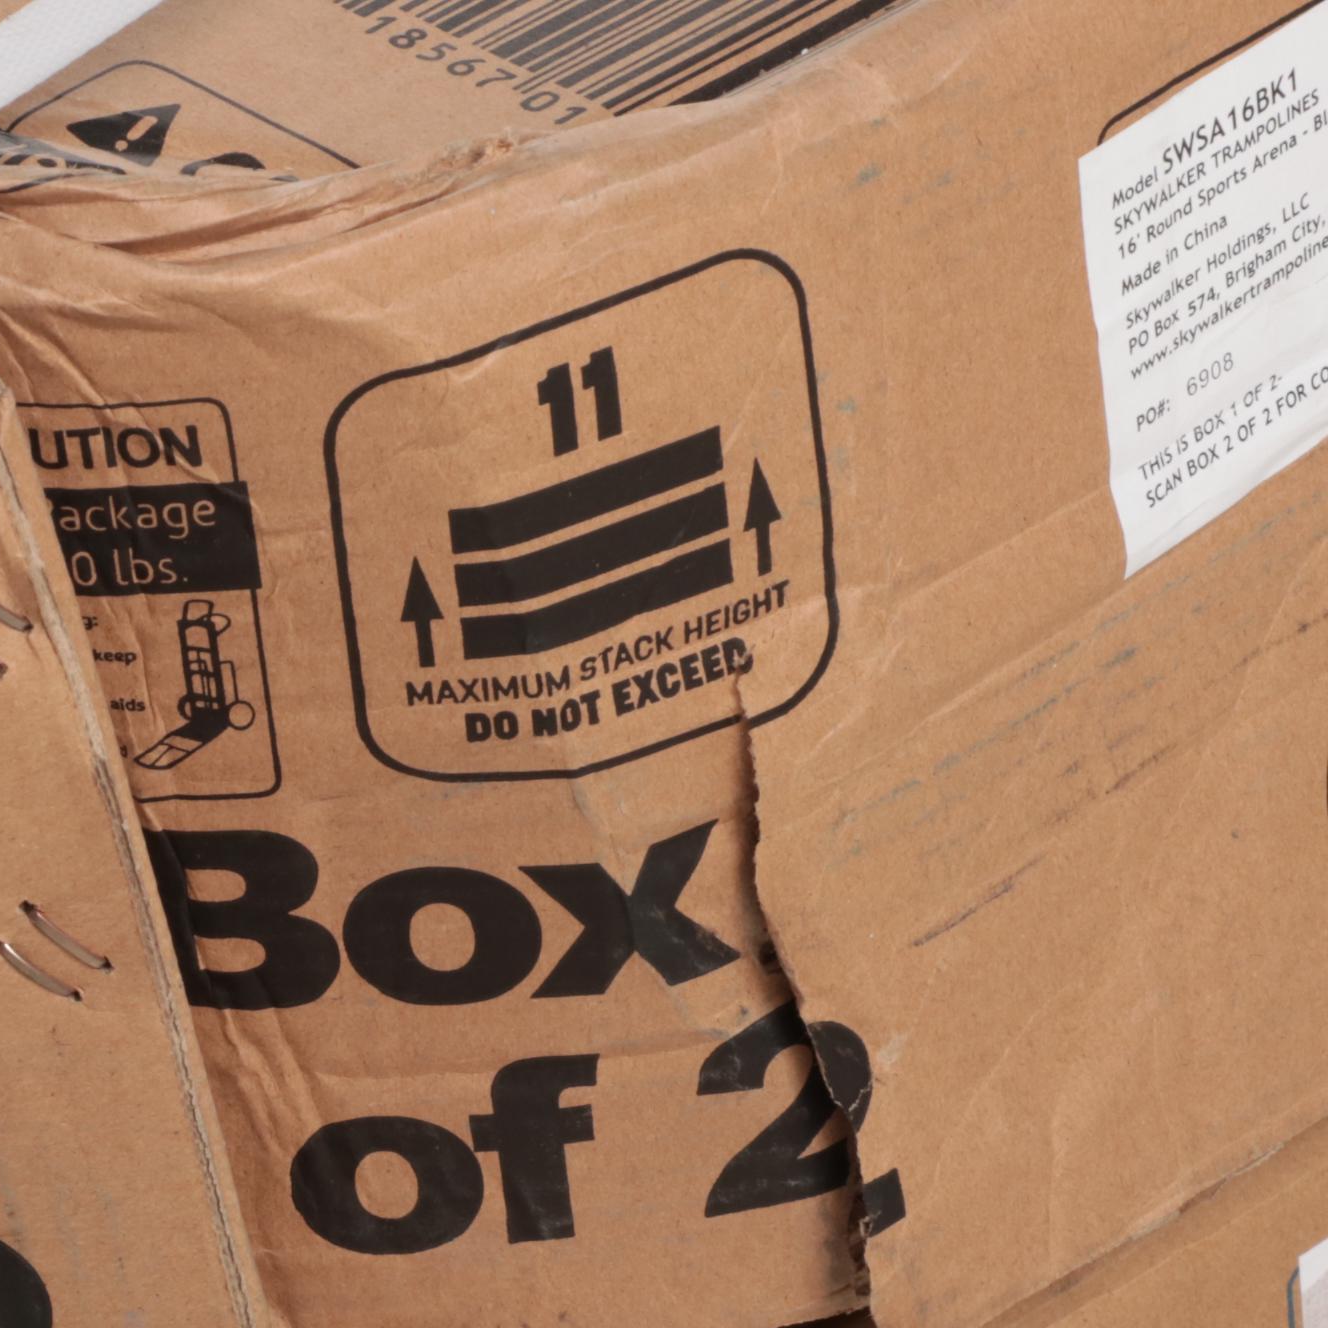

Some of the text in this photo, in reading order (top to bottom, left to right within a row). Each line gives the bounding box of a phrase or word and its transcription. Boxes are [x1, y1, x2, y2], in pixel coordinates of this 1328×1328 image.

[1111, 67, 1298, 209] Model SWSA16BK1
[1113, 88, 1320, 235] SKYWALKER TRAMPOLINES
[1146, 134, 1298, 244] Round Sports Arena
[1121, 214, 1228, 296] Made in China
[1125, 193, 1310, 330] Skywalker Holdings, LLC
[1128, 214, 1327, 355] PO Box 574, Brigham City,
[536, 345, 623, 457] 11
[1136, 351, 1234, 432] PO#: 6908
[1138, 383, 1262, 481] THIS IS BOX OF
[1145, 383, 1307, 508] SCAN BOX 2 OF 2 FOR
[55, 495, 217, 539] ackage
[112, 547, 189, 587] lbs.
[93, 649, 137, 667] keep
[405, 578, 790, 707] MAXIMUM STACK HEIGHT
[464, 635, 755, 744] DO NOT EXCEED
[110, 697, 146, 712] aids
[142, 817, 742, 1011] Box
[290, 1000, 906, 1256] of 2
